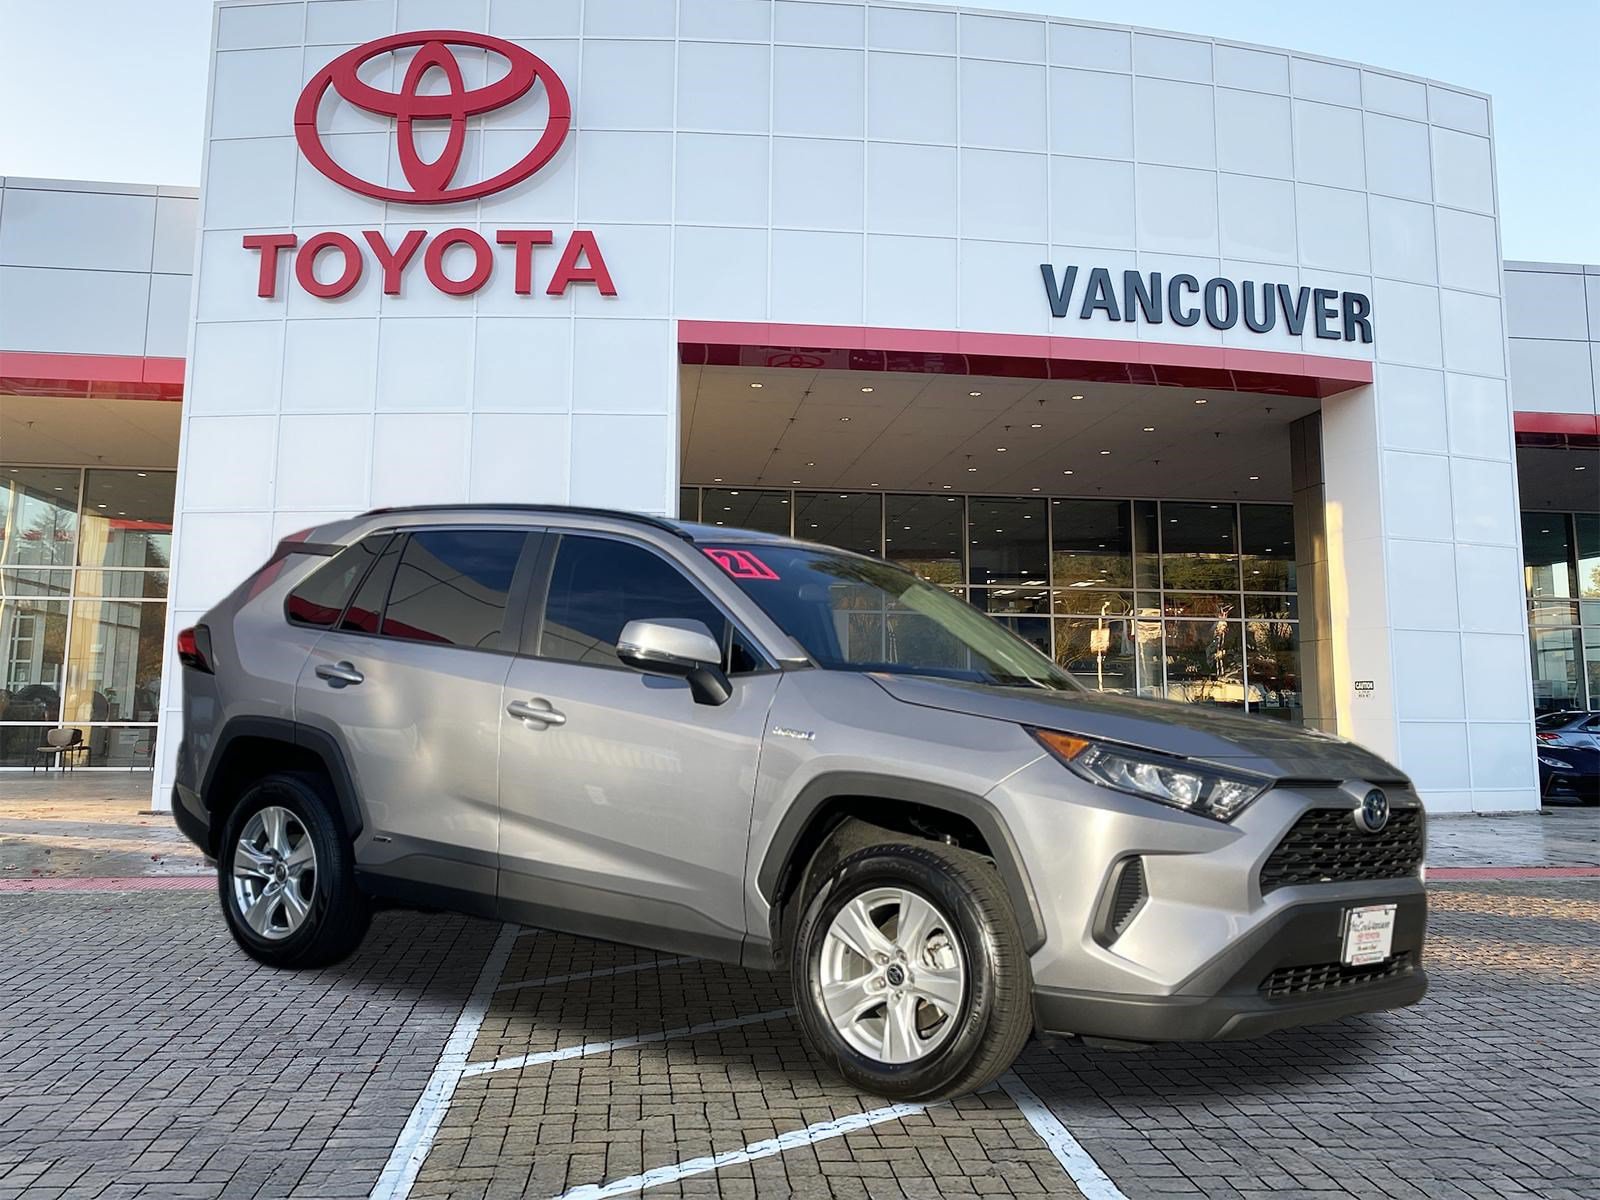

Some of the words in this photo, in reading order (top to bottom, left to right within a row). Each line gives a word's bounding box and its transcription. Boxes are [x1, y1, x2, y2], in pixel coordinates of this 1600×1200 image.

[242, 227, 618, 299] TOYOTA
[1039, 263, 1374, 344] VANCOUVER
[710, 550, 772, 577] 21
